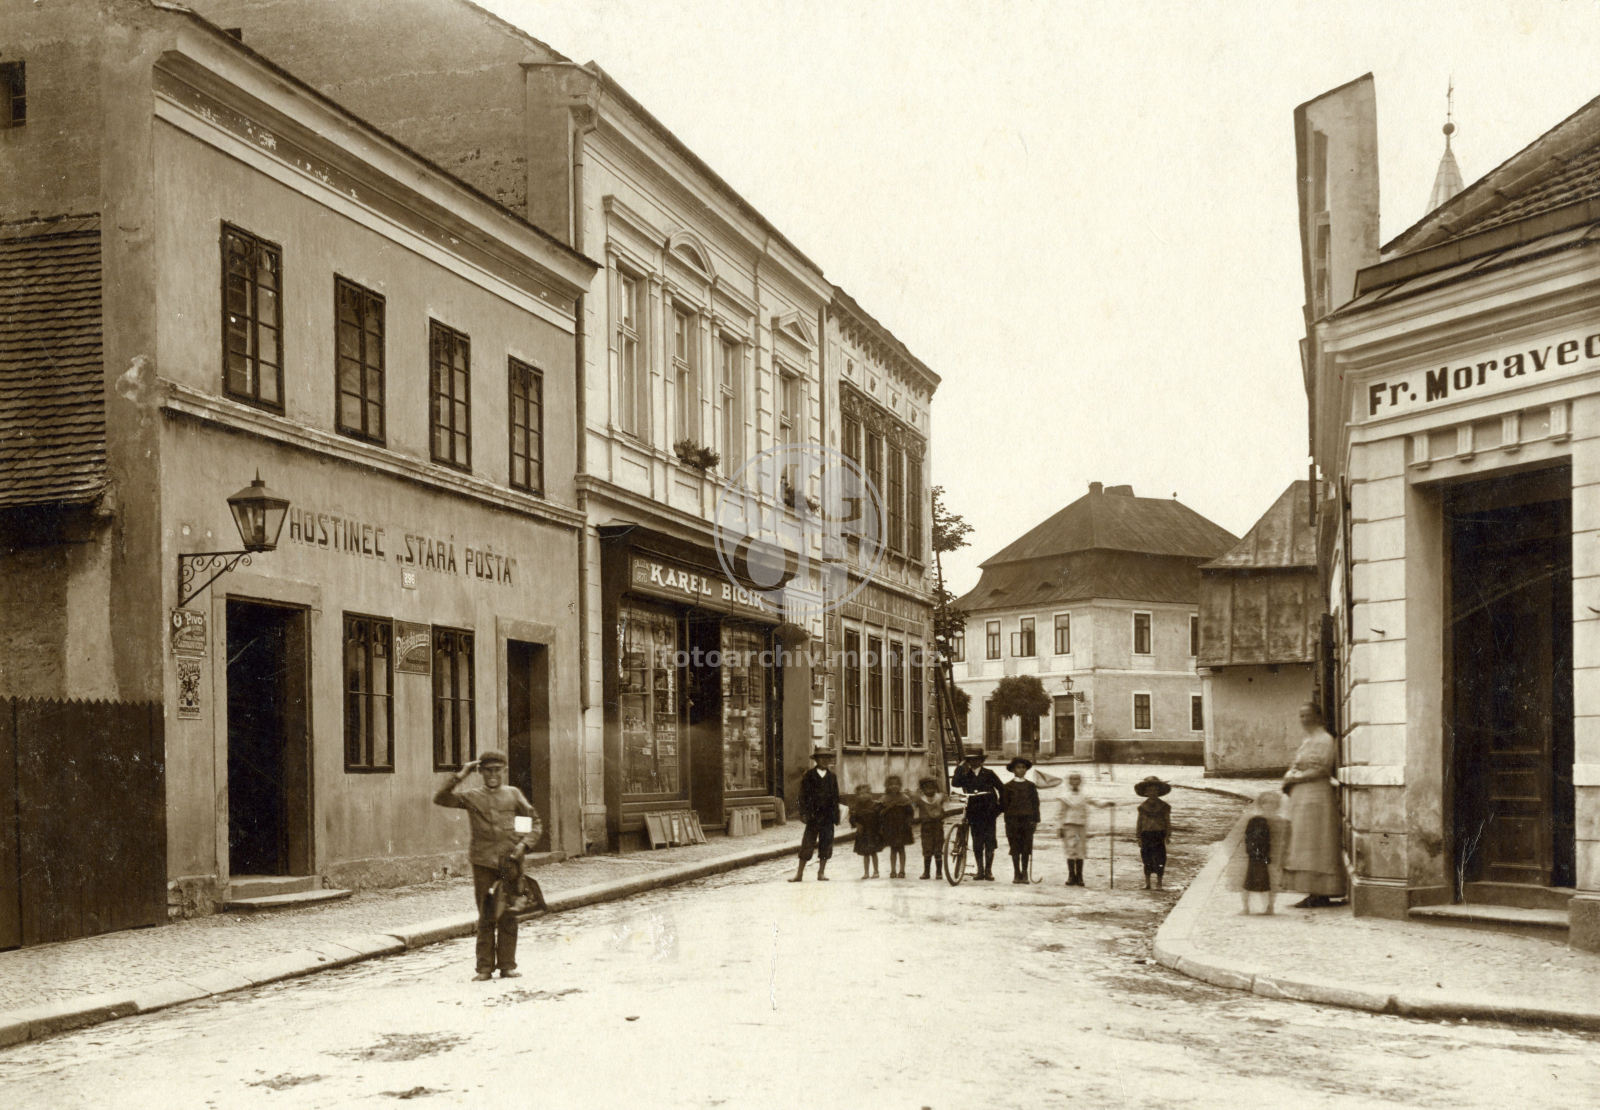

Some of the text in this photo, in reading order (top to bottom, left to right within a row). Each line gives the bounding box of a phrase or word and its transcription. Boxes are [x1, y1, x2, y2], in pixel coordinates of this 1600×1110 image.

[1369, 381, 1417, 416] Fr.
[289, 507, 386, 560] HOSTINEC
[650, 563, 712, 596] KAREL
